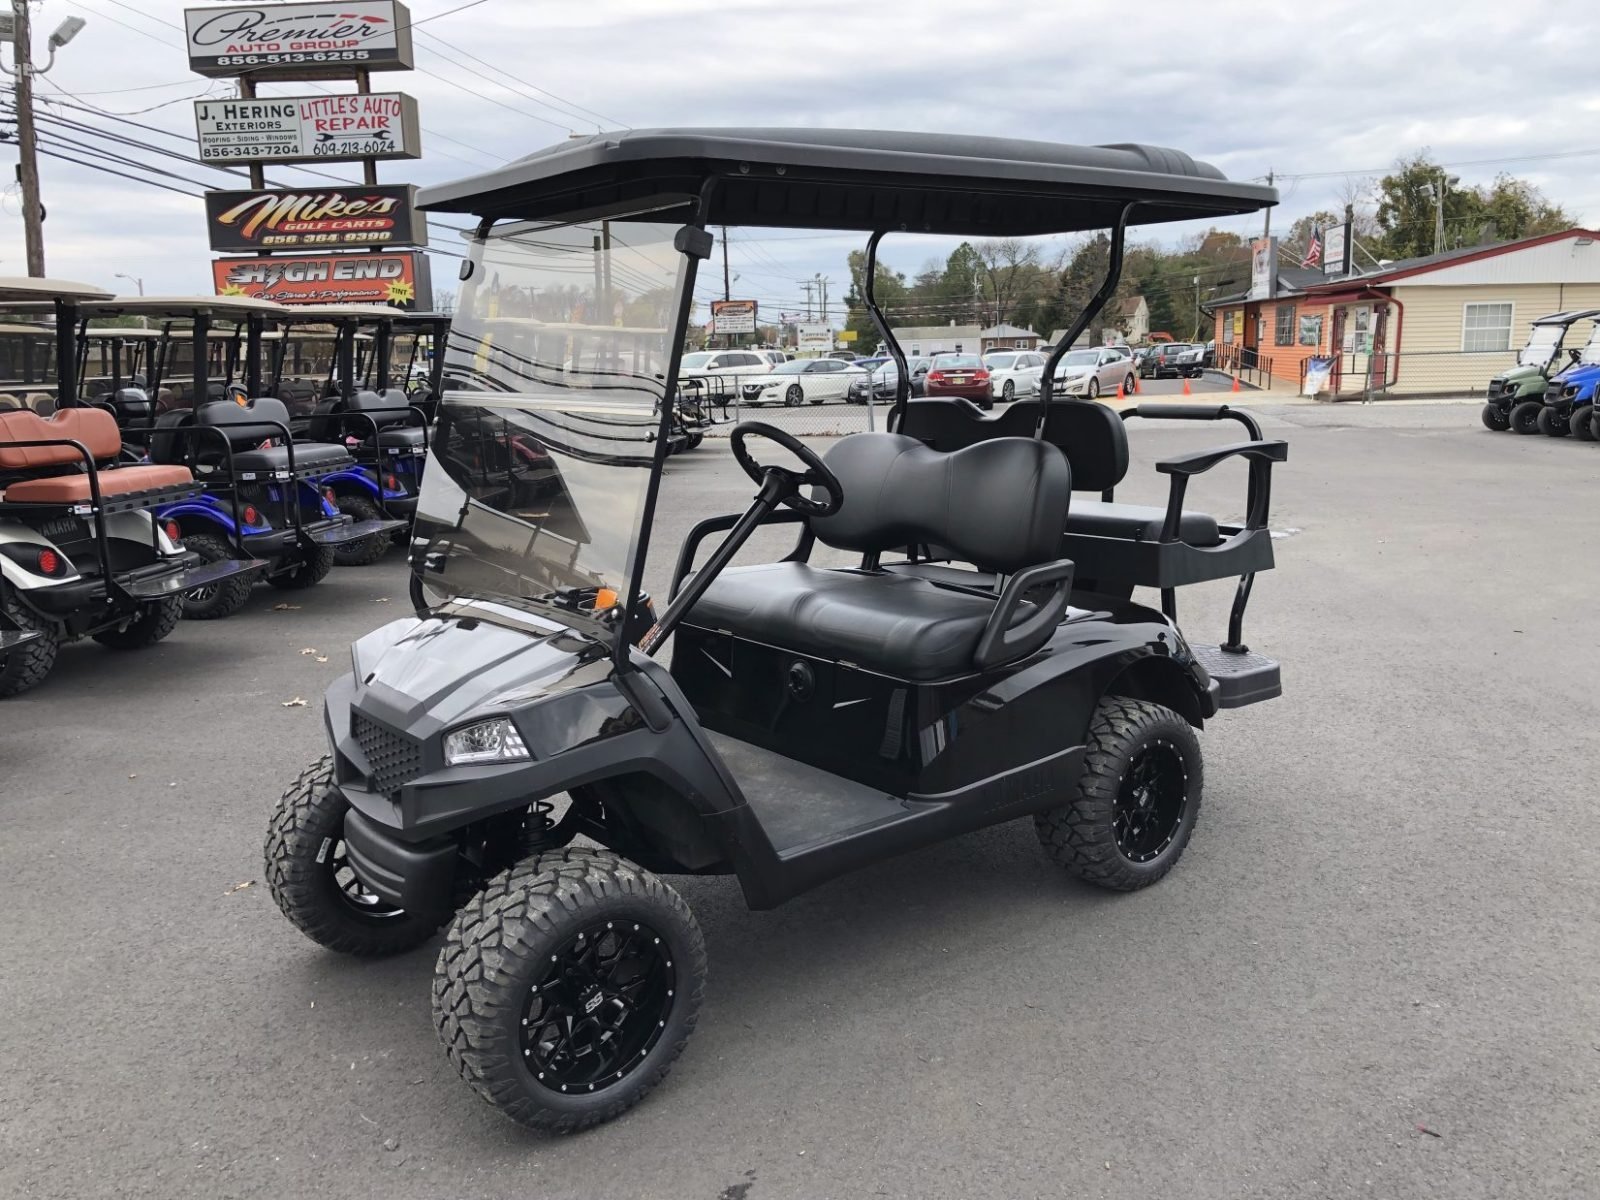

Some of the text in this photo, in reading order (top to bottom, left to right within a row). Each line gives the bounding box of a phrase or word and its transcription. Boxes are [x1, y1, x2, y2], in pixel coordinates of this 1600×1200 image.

[192, 10, 377, 45] Premier
[226, 39, 359, 54] AUTO GROUP
[217, 50, 370, 66] 856-513-6255
[200, 104, 296, 121] J. HERING
[300, 98, 401, 121] LITTLE'S AUTO
[216, 120, 282, 131] EXTERIORS
[315, 116, 391, 132] REPAIR
[202, 136, 231, 144] ROOFING
[313, 139, 395, 156] 609-213-6024
[203, 145, 300, 158] 856-343-7204
[284, 219, 387, 232] GOLF CARTS
[332, 259, 404, 281] END
[251, 290, 274, 301] Car
[276, 290, 308, 301] Stereo
[318, 289, 381, 302] Performance
[391, 287, 408, 296] TINT
